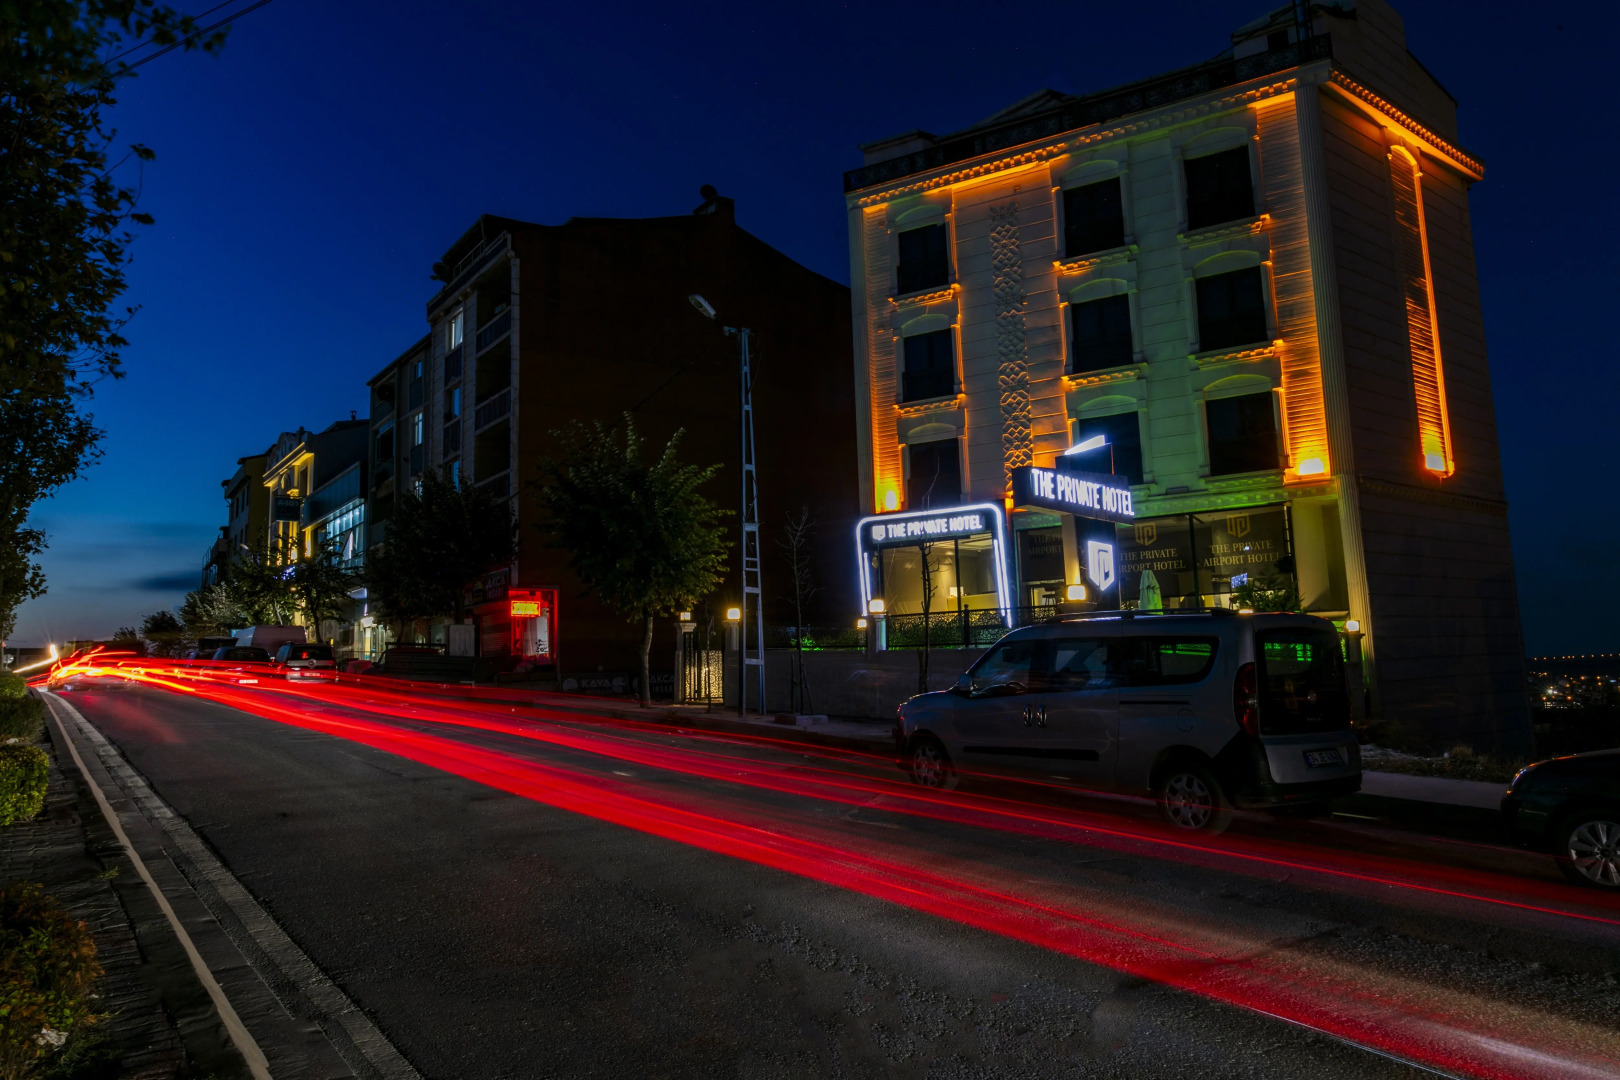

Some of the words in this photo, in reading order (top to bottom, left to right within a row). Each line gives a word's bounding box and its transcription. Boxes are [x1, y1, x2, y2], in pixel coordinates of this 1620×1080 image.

[1031, 468, 1055, 499] THE
[1056, 474, 1100, 509] PRIVATE
[1102, 485, 1135, 516] HOTEL
[887, 523, 906, 538] THE
[907, 518, 948, 536] PRIVATE
[949, 514, 983, 532] HOTEL
[1209, 543, 1231, 554] THE
[1232, 539, 1273, 552] PRIVATE
[1120, 552, 1137, 561] THE
[1140, 548, 1177, 560] PRIVATE
[1203, 554, 1244, 567] AIRPORT
[1247, 552, 1281, 564] HOTEL
[1118, 562, 1151, 573] IRPORT
[1153, 560, 1186, 571] HOTEL
[581, 679, 610, 688] KAYA
